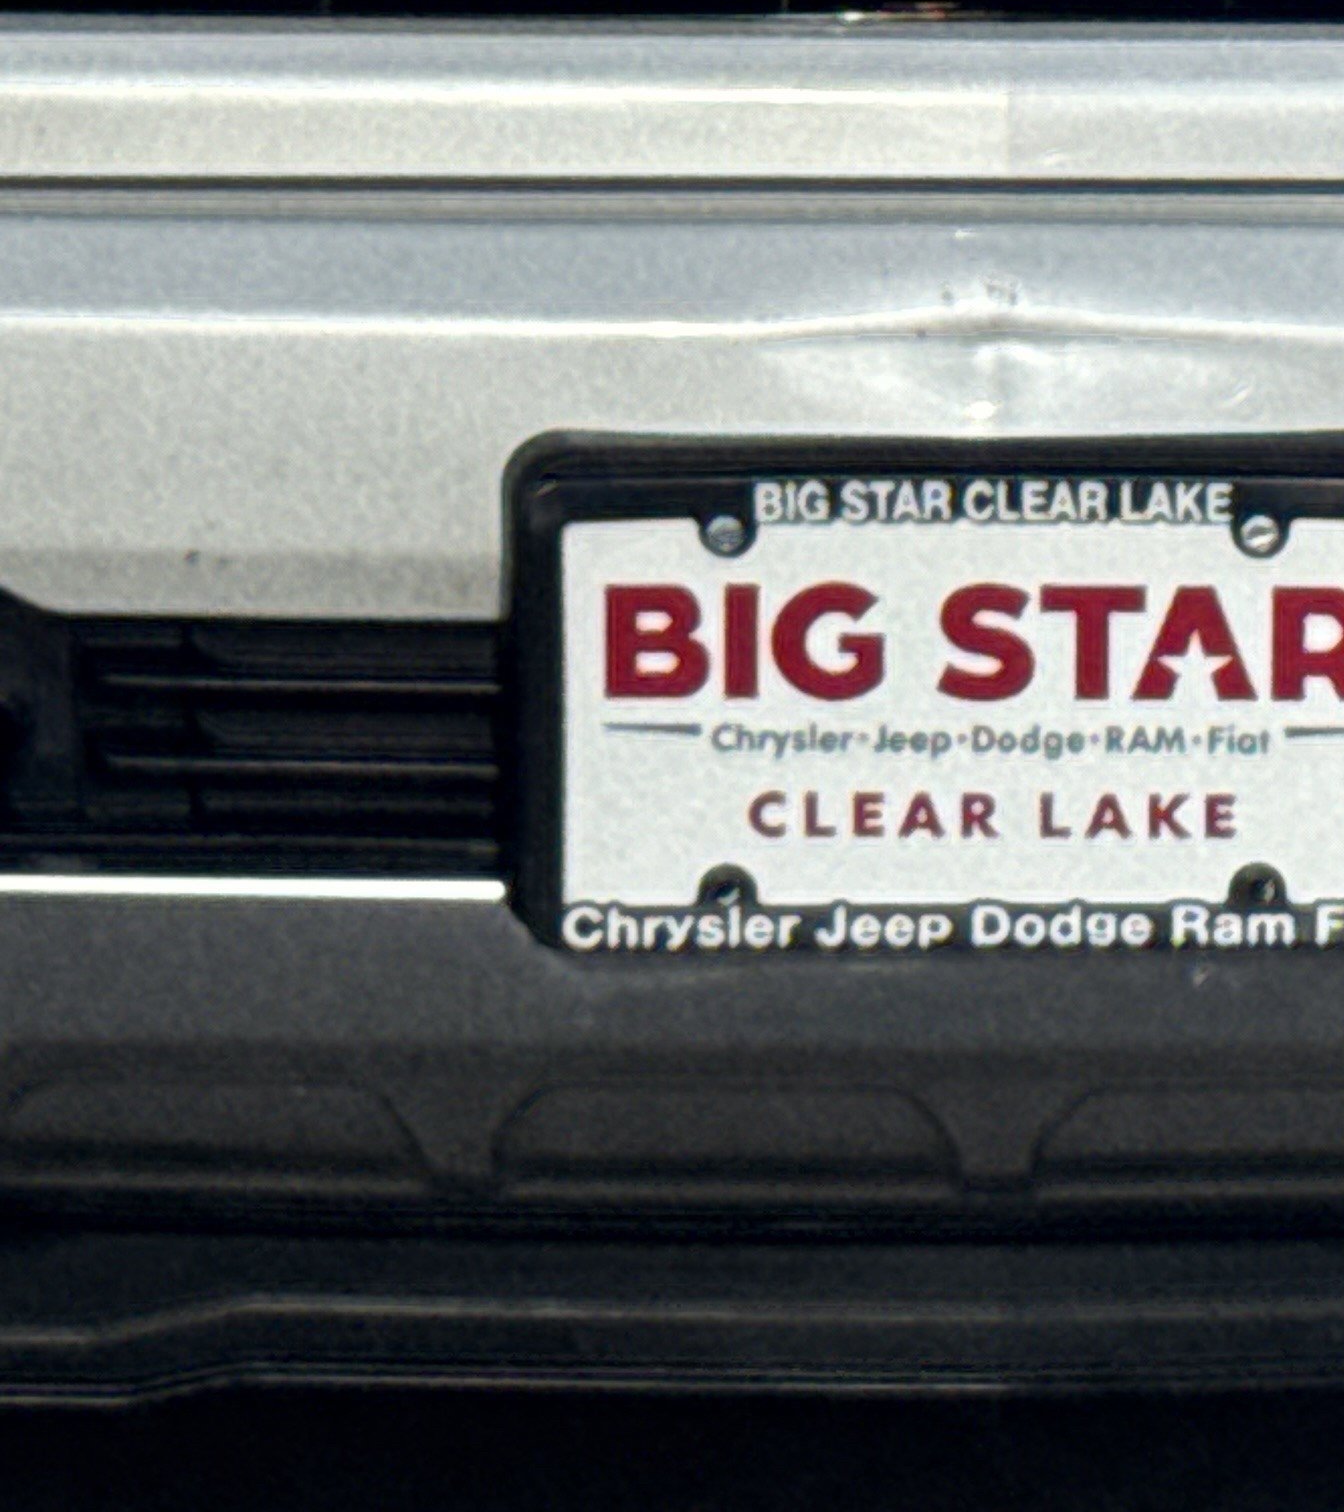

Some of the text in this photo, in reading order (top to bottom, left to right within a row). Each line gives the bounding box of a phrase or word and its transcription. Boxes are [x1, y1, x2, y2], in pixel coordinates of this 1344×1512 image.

[753, 481, 1233, 522] BIG STAR CLEAR LAKE
[604, 581, 886, 702] BIG
[748, 790, 1238, 839] CLEAR LAKE
[561, 904, 803, 951] Chrysler
[814, 904, 954, 950] Jeep
[970, 904, 1154, 949] Dodge
[1171, 903, 1296, 947] Ram
